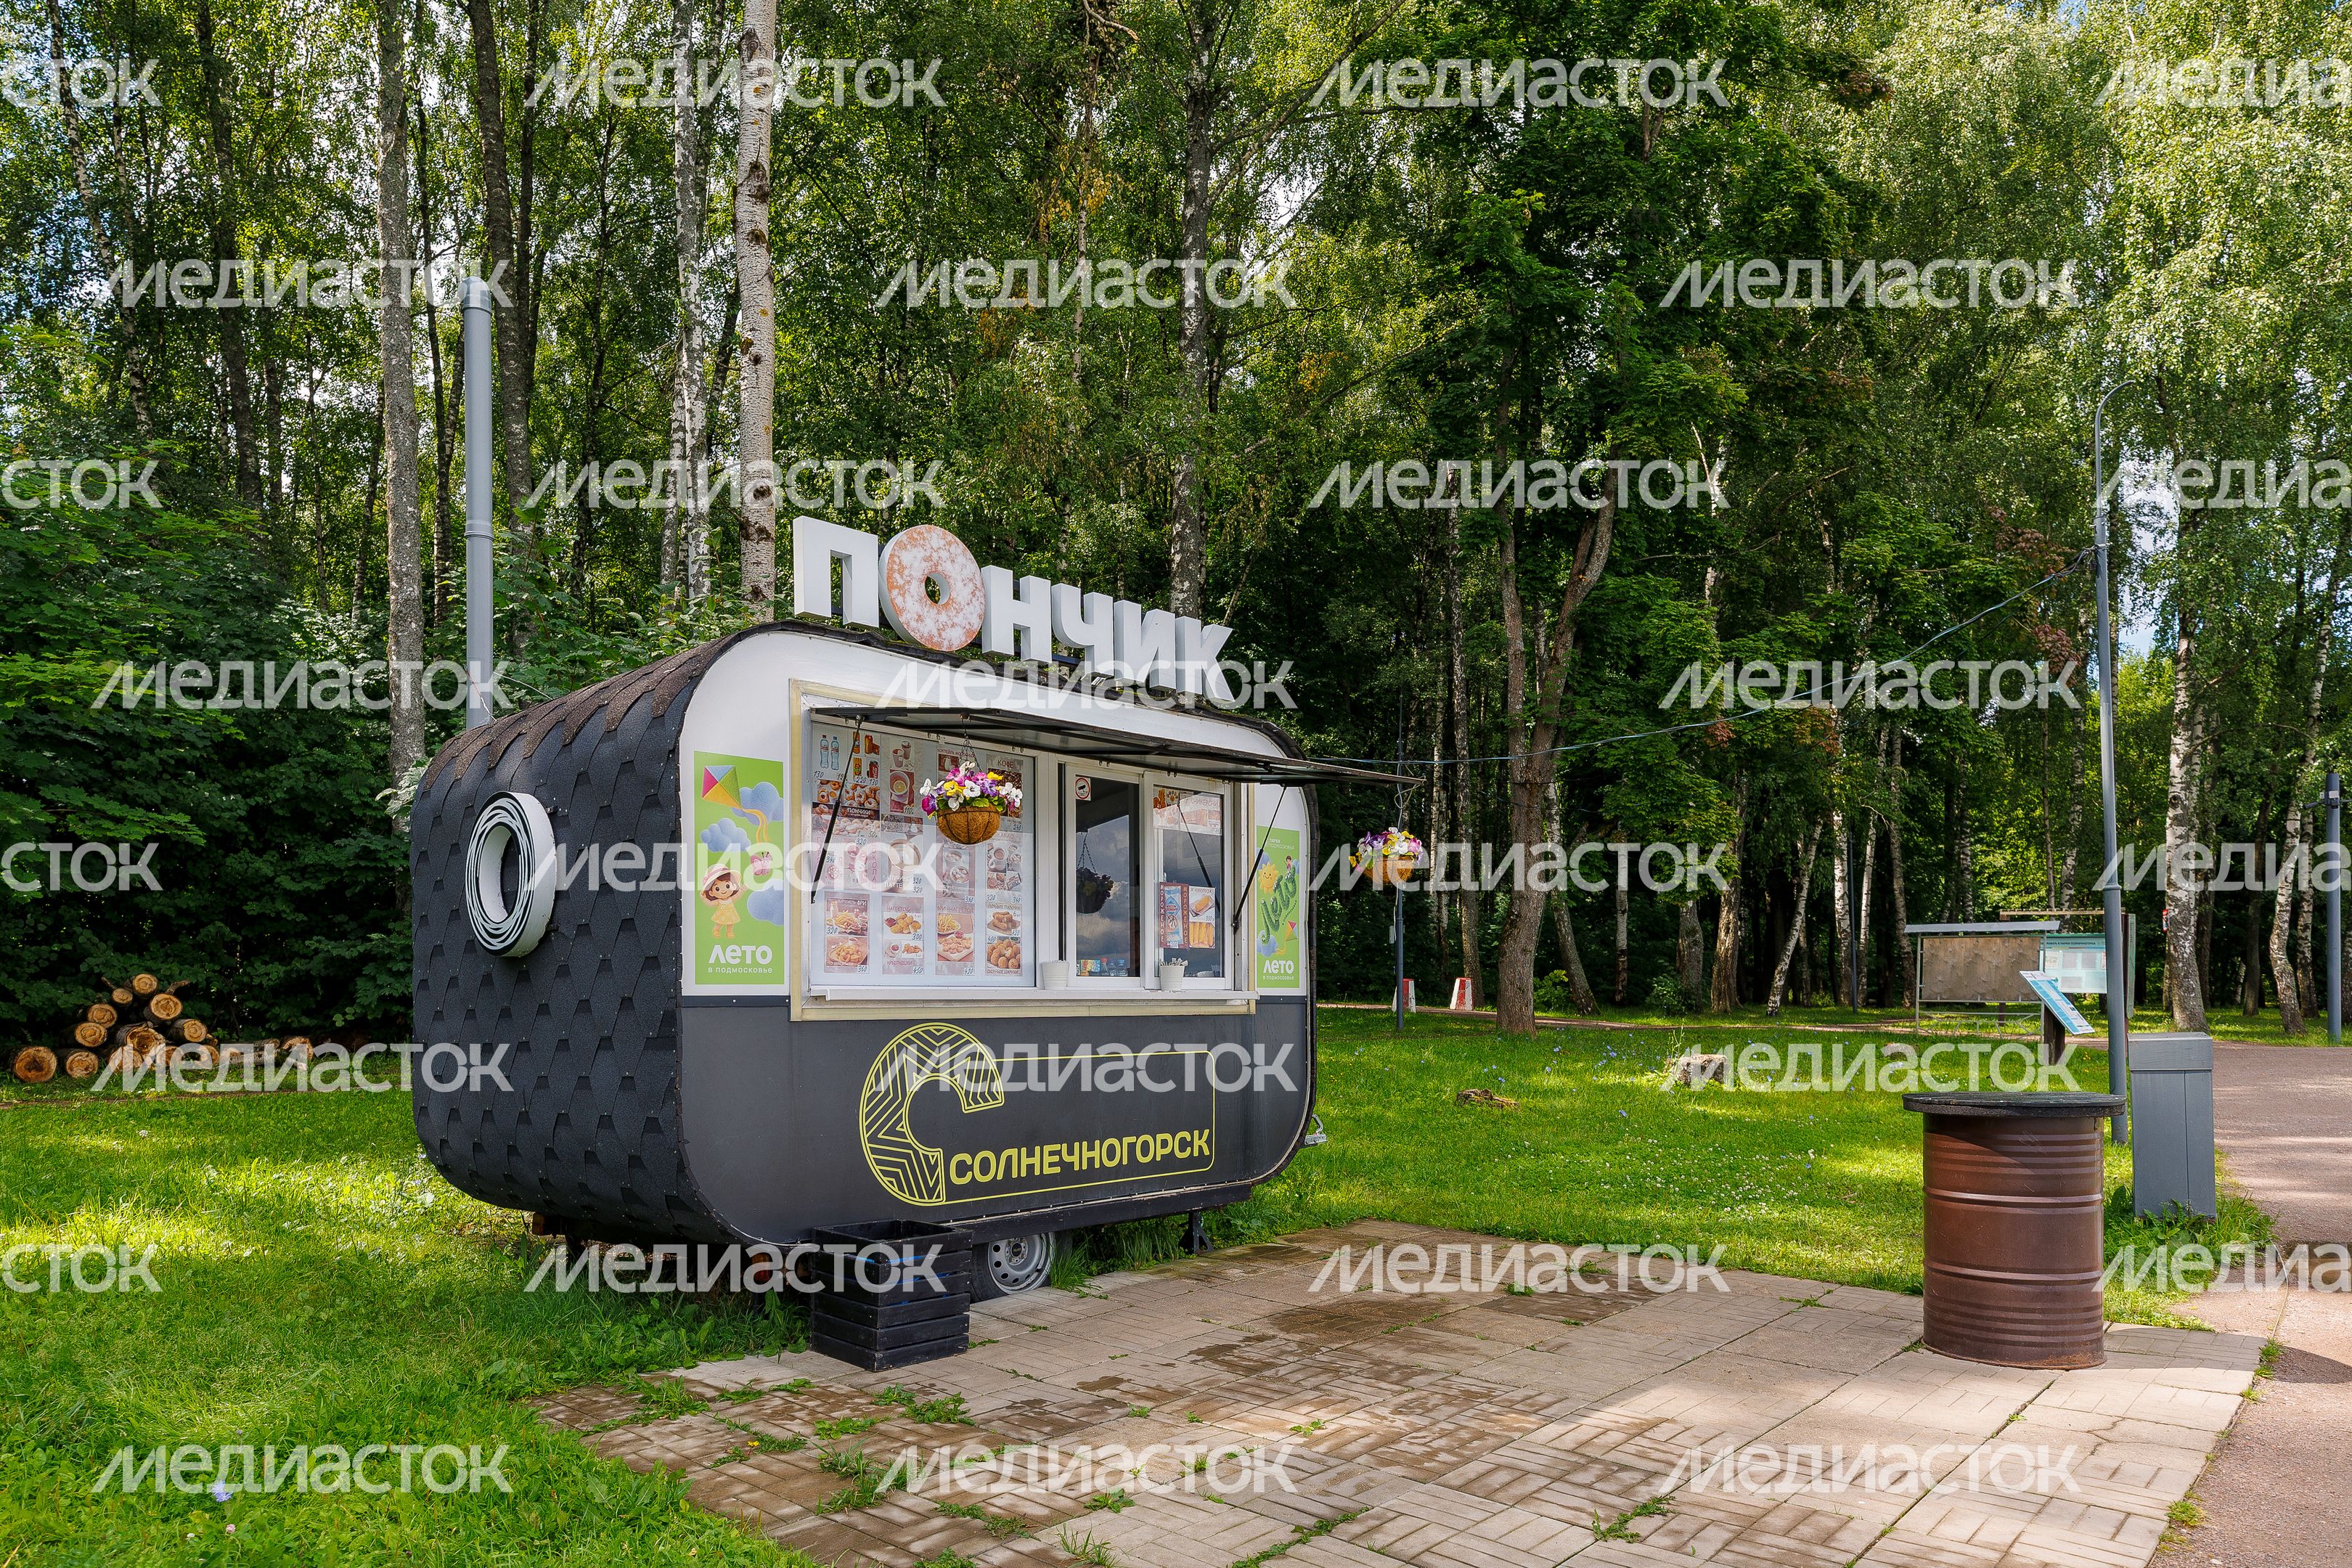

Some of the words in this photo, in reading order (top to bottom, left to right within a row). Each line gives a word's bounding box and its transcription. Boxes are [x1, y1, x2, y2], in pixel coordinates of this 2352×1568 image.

[793, 515, 1233, 703] ПОНЧИК
[997, 759, 1013, 769] КОФЕ
[948, 1128, 1211, 1185] СОЛНЕЧНОГОРСК
